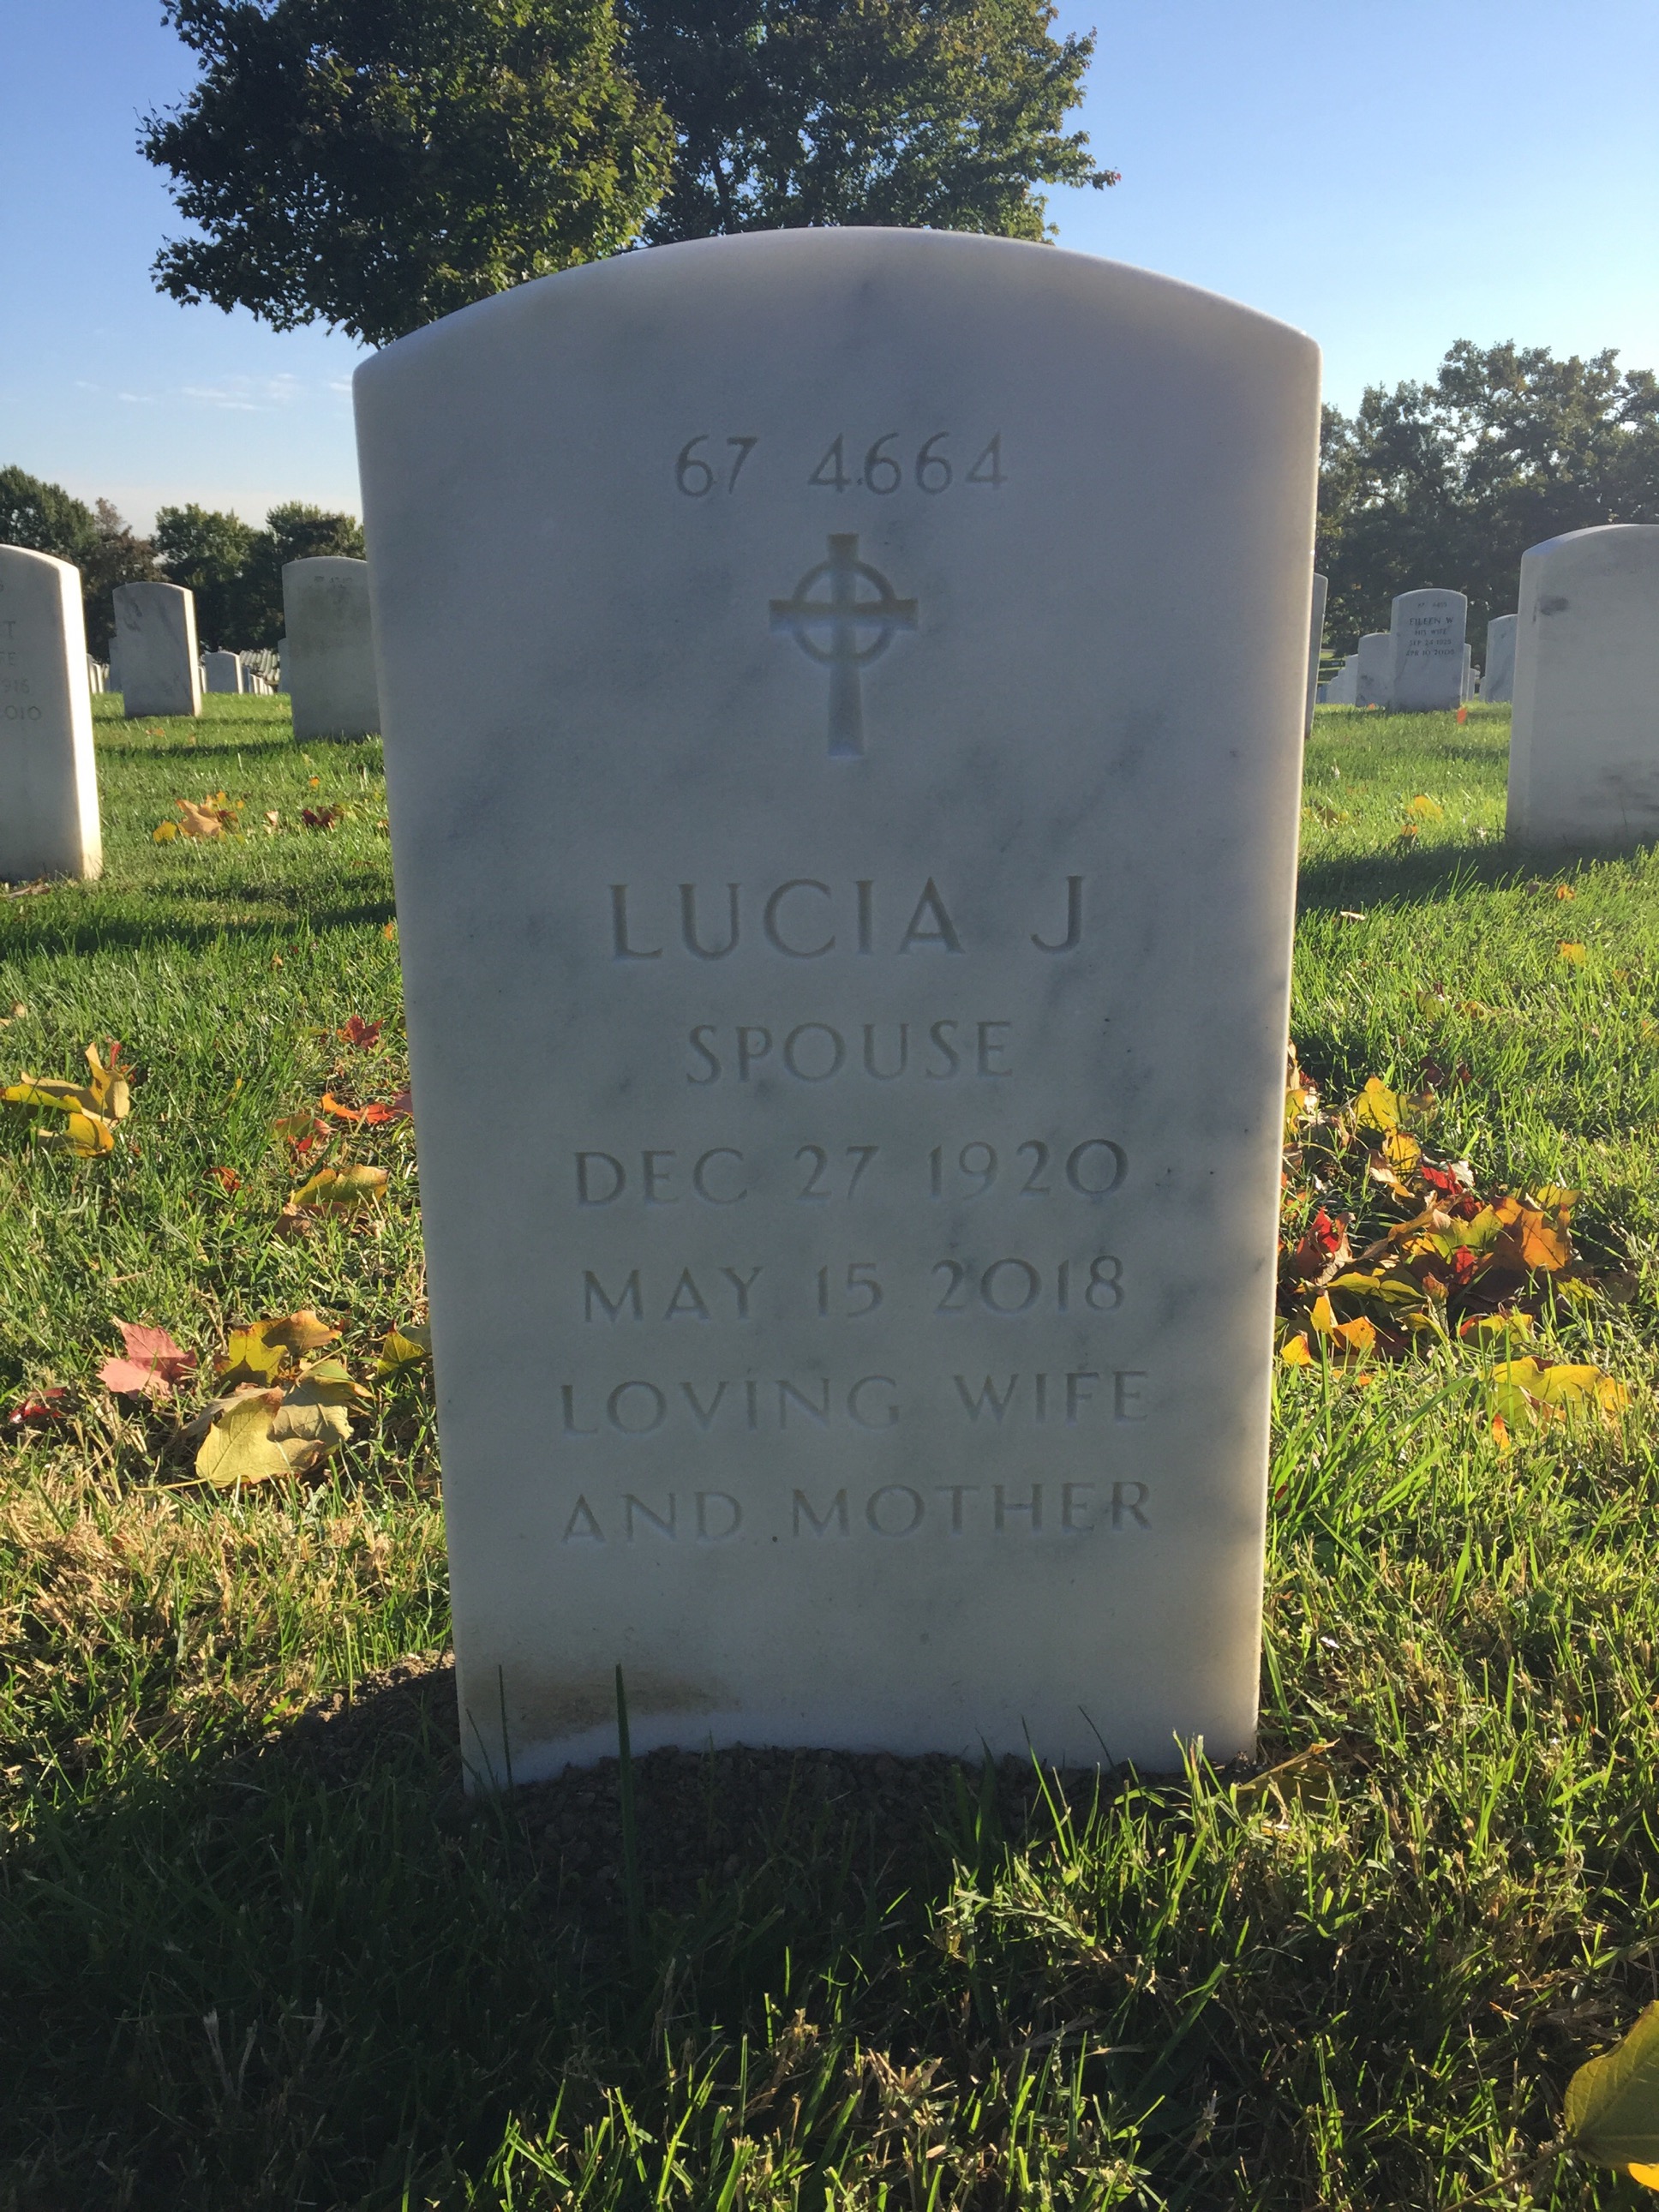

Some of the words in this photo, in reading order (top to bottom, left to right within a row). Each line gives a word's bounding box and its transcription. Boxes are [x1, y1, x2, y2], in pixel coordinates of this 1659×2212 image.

[674, 433, 759, 498] 67
[806, 430, 1009, 495] 4664
[1409, 616, 1441, 626] EILEEN
[3, 705, 43, 721] 010
[608, 876, 966, 962] LUCIA
[1030, 875, 1084, 956] J
[686, 1020, 1014, 1085] SPOUSE
[573, 1147, 748, 1205] DEC
[794, 1144, 881, 1202] 27
[926, 1138, 1129, 1201] 1920
[581, 1265, 764, 1324] MAY
[816, 1262, 884, 1318] 15
[931, 1255, 1126, 1316] 2018
[560, 1374, 901, 1437] LOVING
[953, 1370, 1150, 1425] WIFE
[561, 1491, 744, 1544] AND
[791, 1480, 1153, 1540] MOTHER
